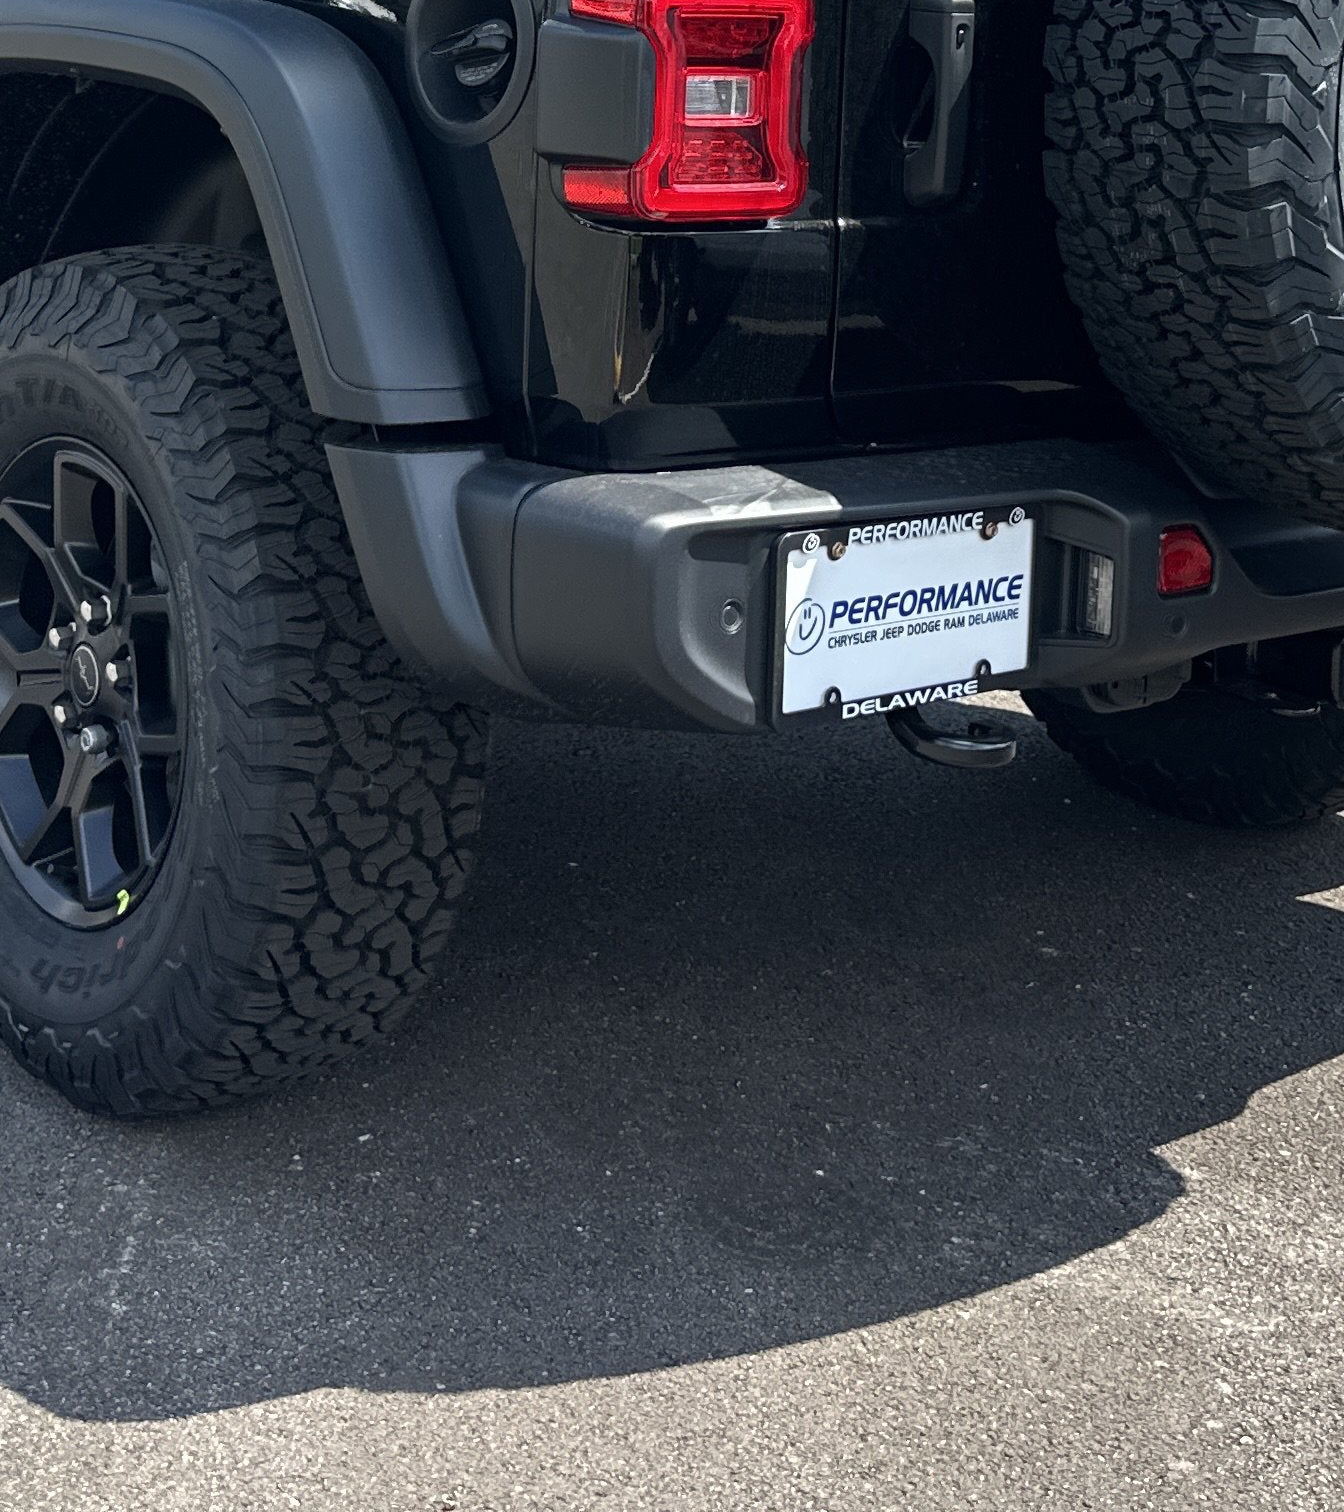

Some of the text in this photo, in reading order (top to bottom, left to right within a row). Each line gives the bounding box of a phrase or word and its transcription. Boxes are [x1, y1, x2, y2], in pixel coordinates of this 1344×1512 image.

[847, 511, 984, 545] PERFORMANCE
[828, 574, 1024, 628] PERFORMANCE
[827, 607, 1019, 649] CHRYSLER JEEP DODGE RAM DELAWARE
[842, 679, 979, 719] DELAWARE
